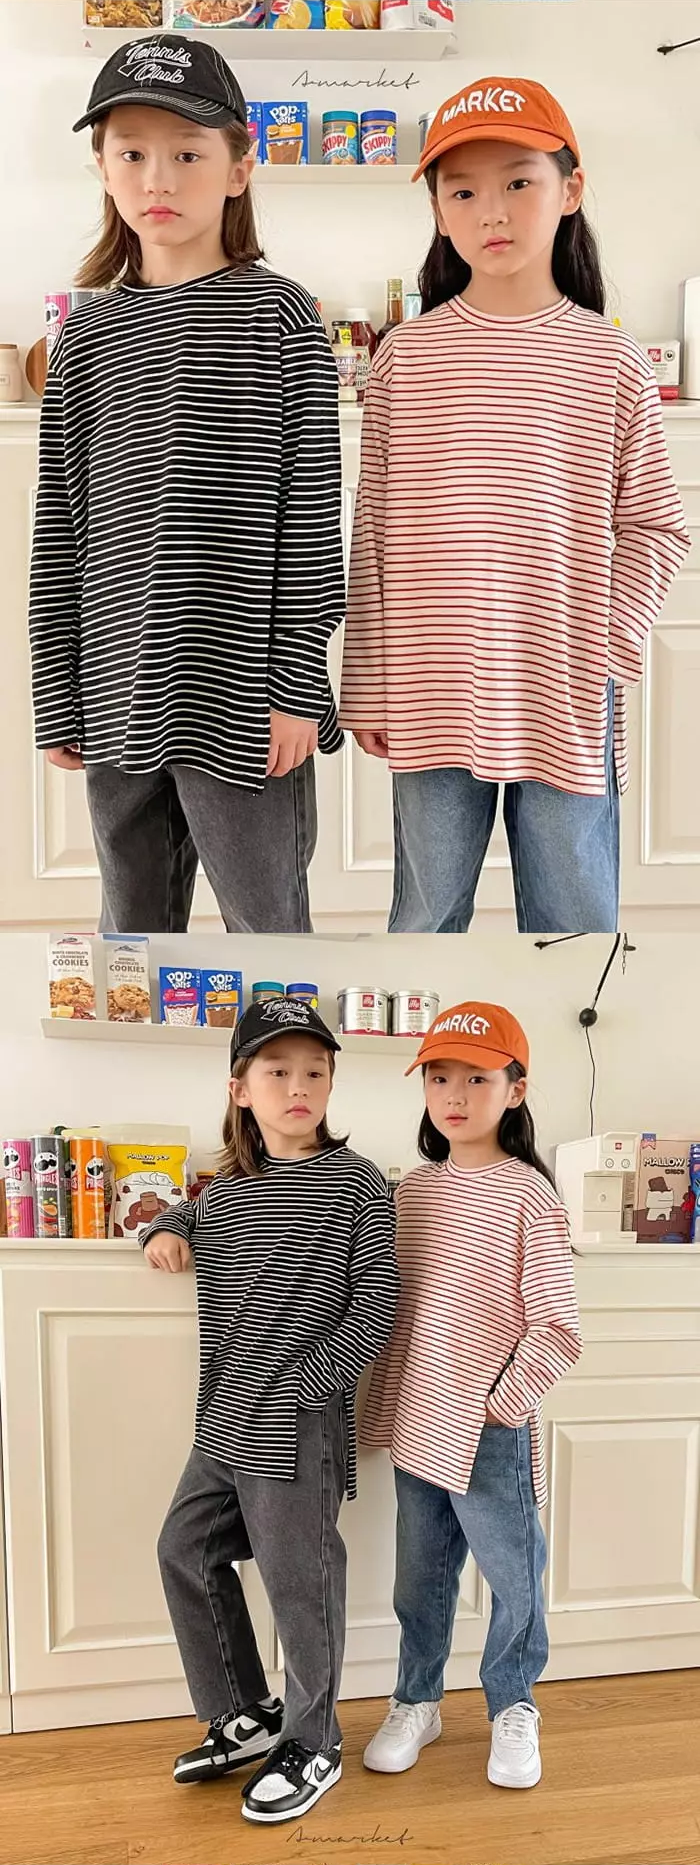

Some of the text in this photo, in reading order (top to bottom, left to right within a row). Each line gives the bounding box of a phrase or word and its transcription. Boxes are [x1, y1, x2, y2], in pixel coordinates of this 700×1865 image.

[126, 41, 193, 67] Tennis
[134, 63, 185, 84] Club
[441, 87, 527, 125] MARKET
[363, 135, 392, 154] SKIPPY
[52, 959, 89, 967] COOKIES
[109, 964, 145, 973] COOKIES
[433, 1012, 491, 1036] MARKET
[127, 1153, 156, 1161] MALLOW
[643, 1157, 685, 1167] MALLOW
